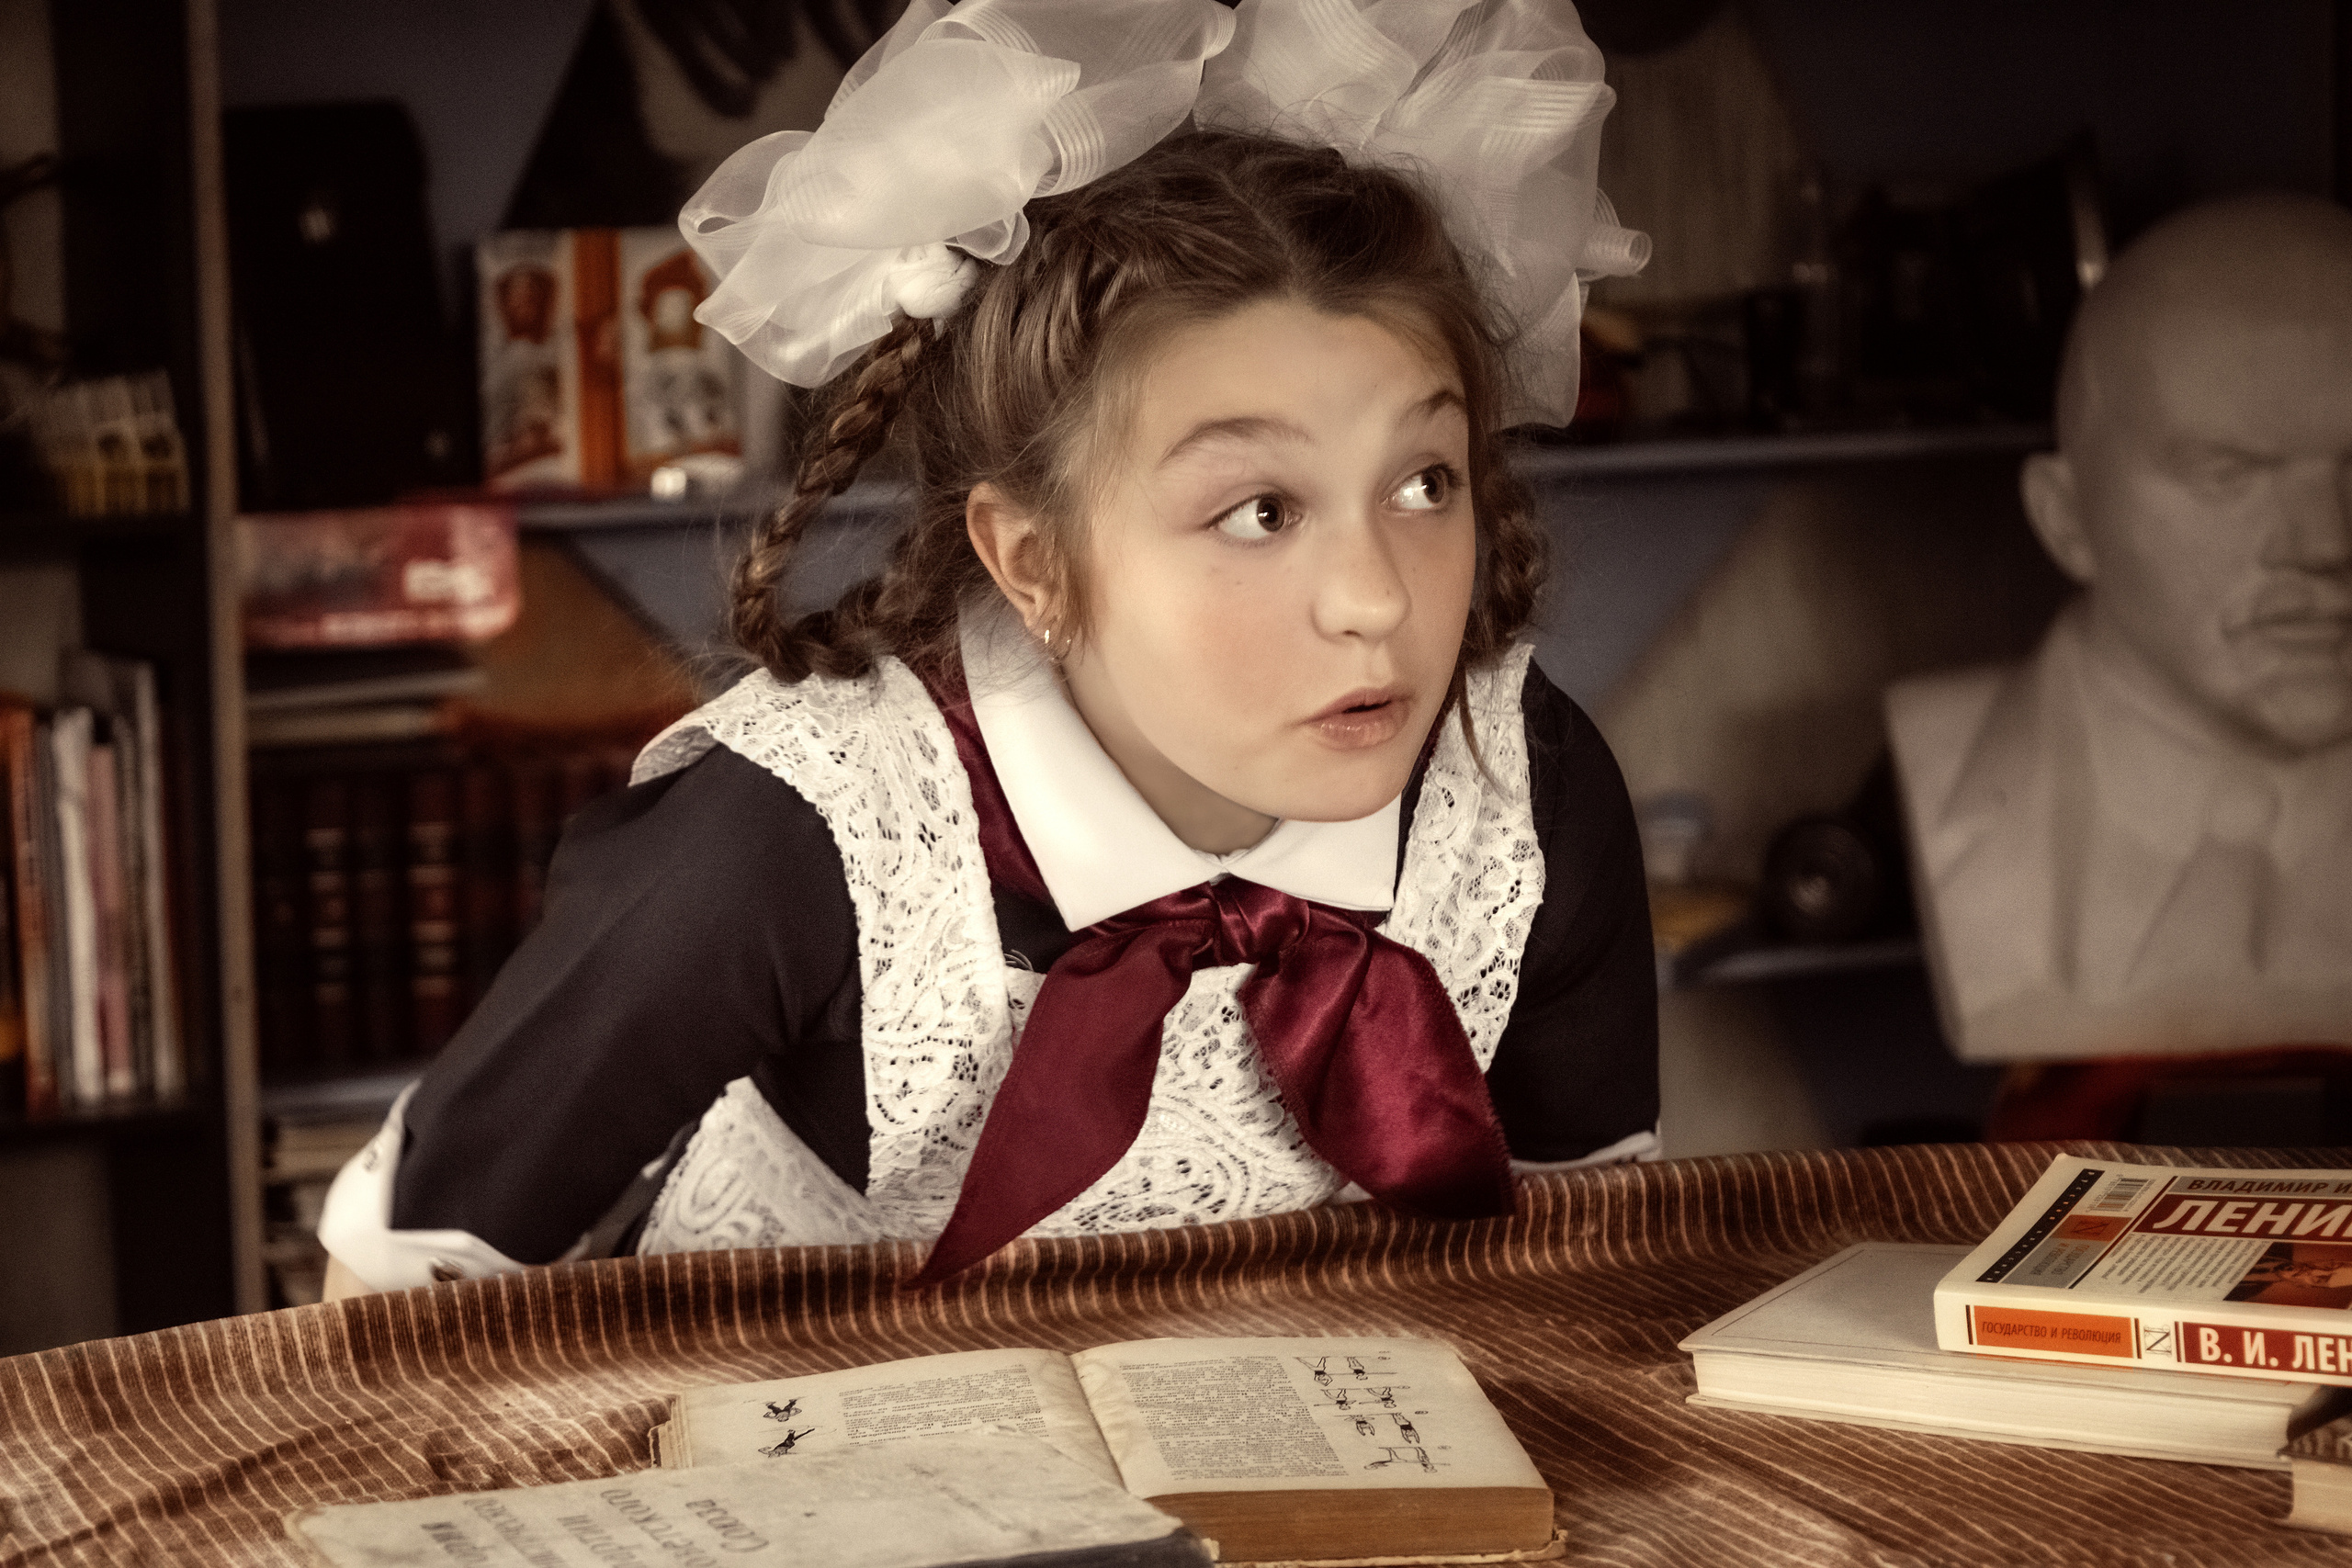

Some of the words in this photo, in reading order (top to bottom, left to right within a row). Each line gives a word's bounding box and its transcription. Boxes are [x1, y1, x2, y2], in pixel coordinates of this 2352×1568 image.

[2187, 1179, 2329, 1194] ВЛАДИМИР
[2152, 1199, 2352, 1238] ЛЕНИ
[1982, 1321, 2047, 1337] ГОСУДАРСТВО
[2050, 1326, 2058, 1338] И
[2061, 1327, 2121, 1344] РЕВОЛЮЦИЯ
[2199, 1326, 2233, 1363] В.
[2243, 1330, 2278, 1368] И.
[599, 1488, 718, 1568] оветского
